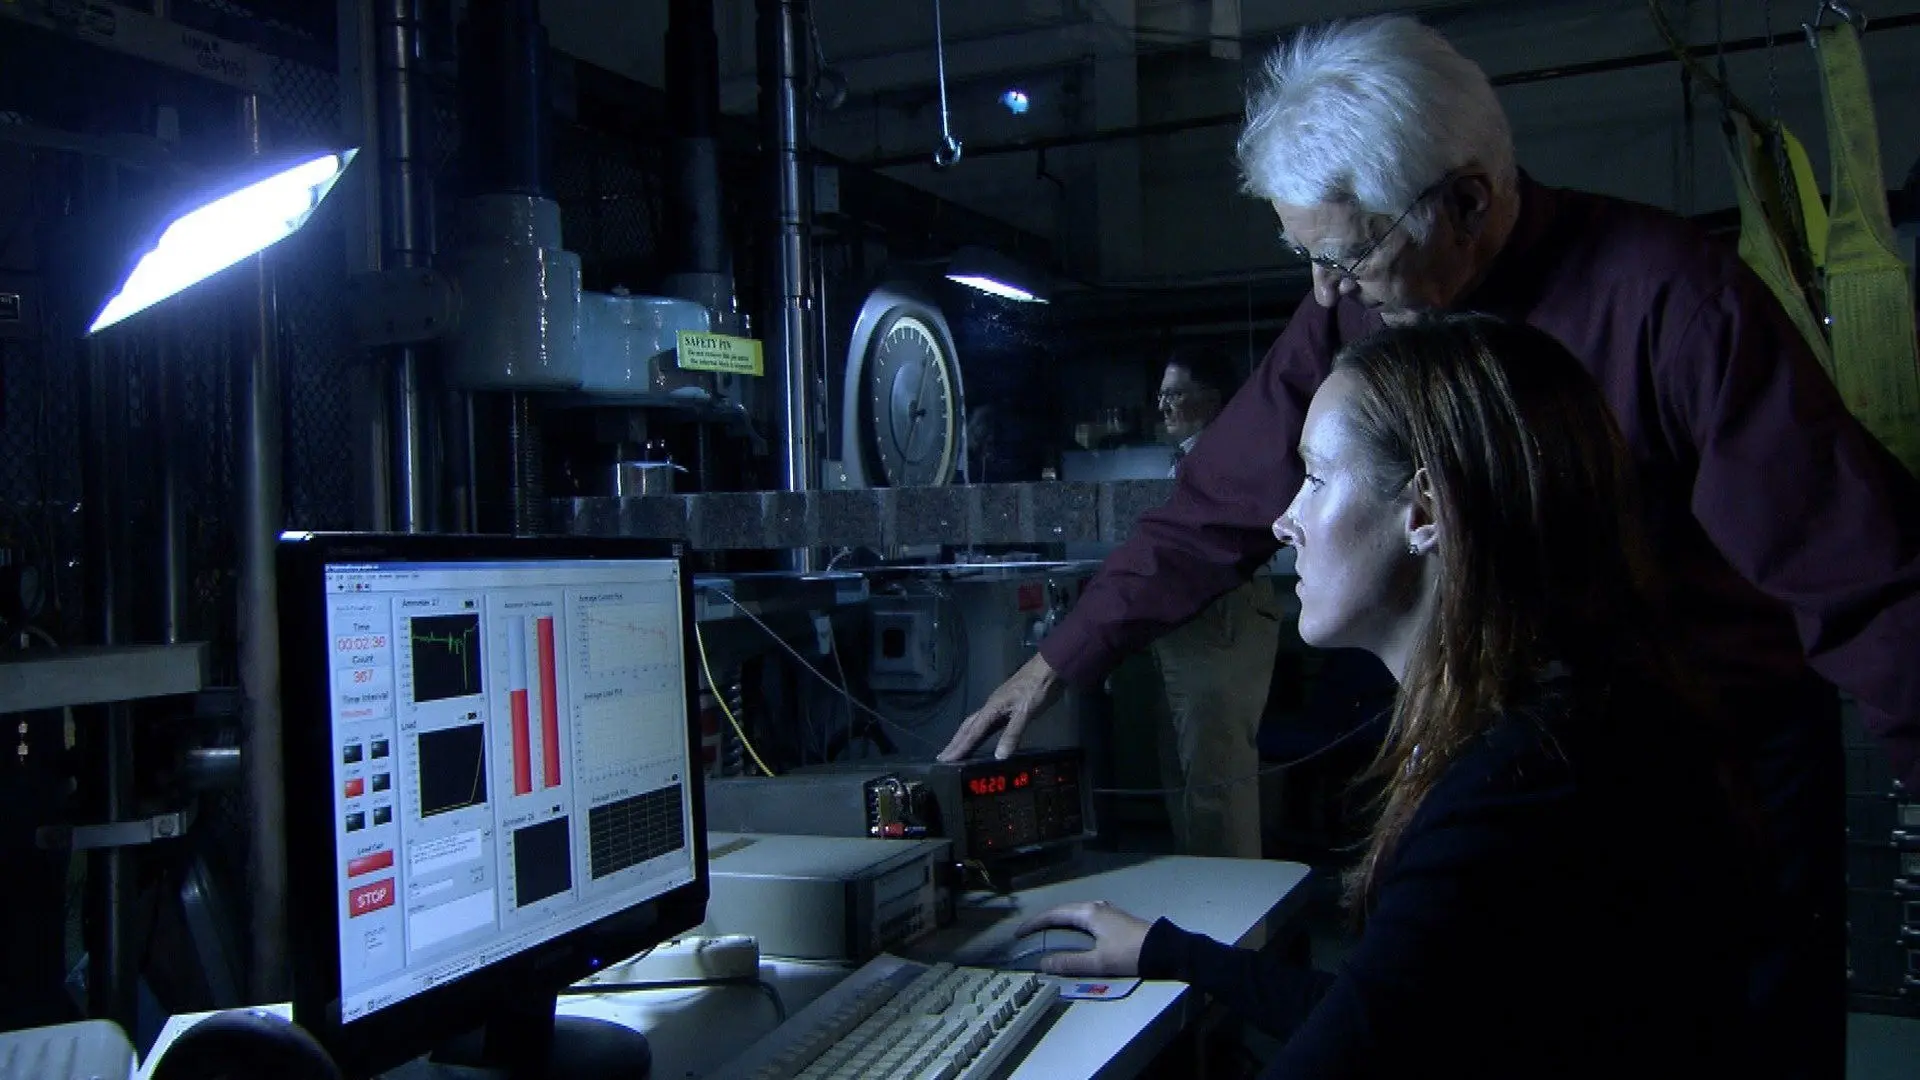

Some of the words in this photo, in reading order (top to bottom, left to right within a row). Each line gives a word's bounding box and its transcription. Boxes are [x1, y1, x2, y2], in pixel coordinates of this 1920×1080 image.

[684, 336, 718, 349] SAFETY
[353, 623, 371, 632] Time
[352, 654, 374, 665] Count
[343, 696, 360, 706] Time
[362, 691, 388, 703] Interval
[356, 887, 387, 909] STOP
